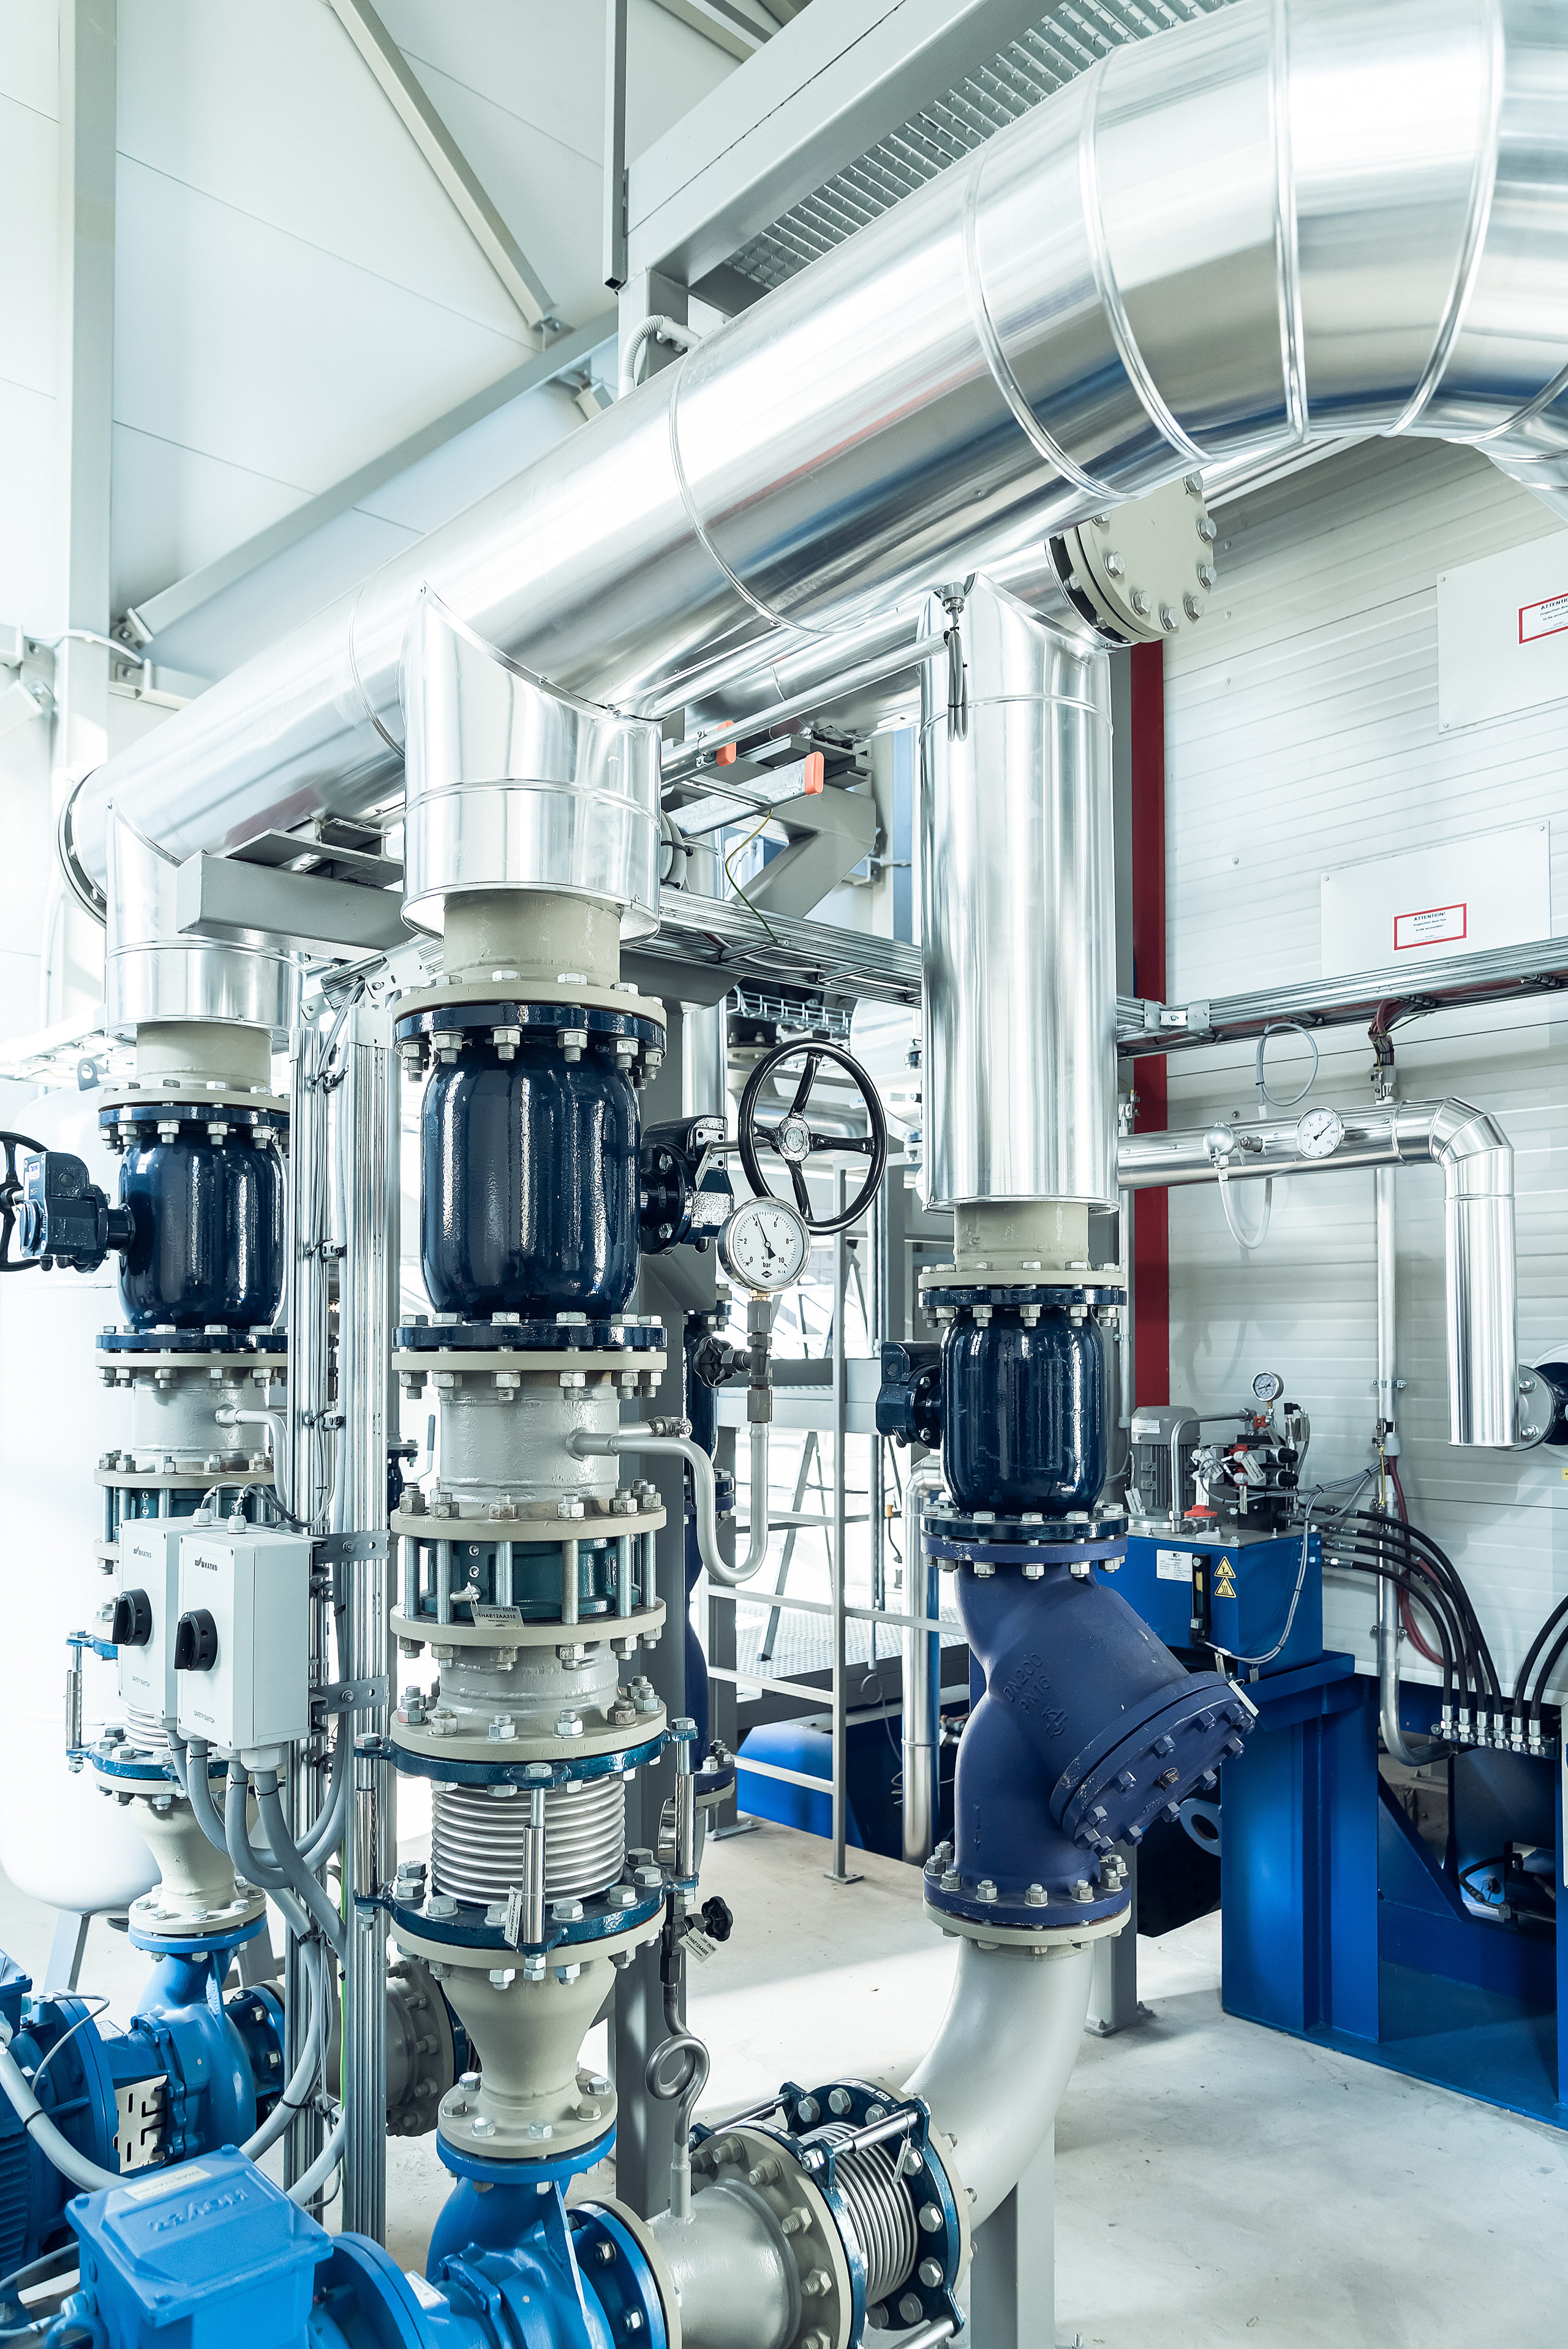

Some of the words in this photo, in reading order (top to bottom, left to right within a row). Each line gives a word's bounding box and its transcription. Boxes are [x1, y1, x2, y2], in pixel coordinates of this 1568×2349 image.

[1414, 911, 1446, 921] ATTENTION!
[205, 1562, 217, 1571] KATKO
[1019, 1676, 1050, 1714] PN16
[204, 1714, 216, 1724] SWITCH
